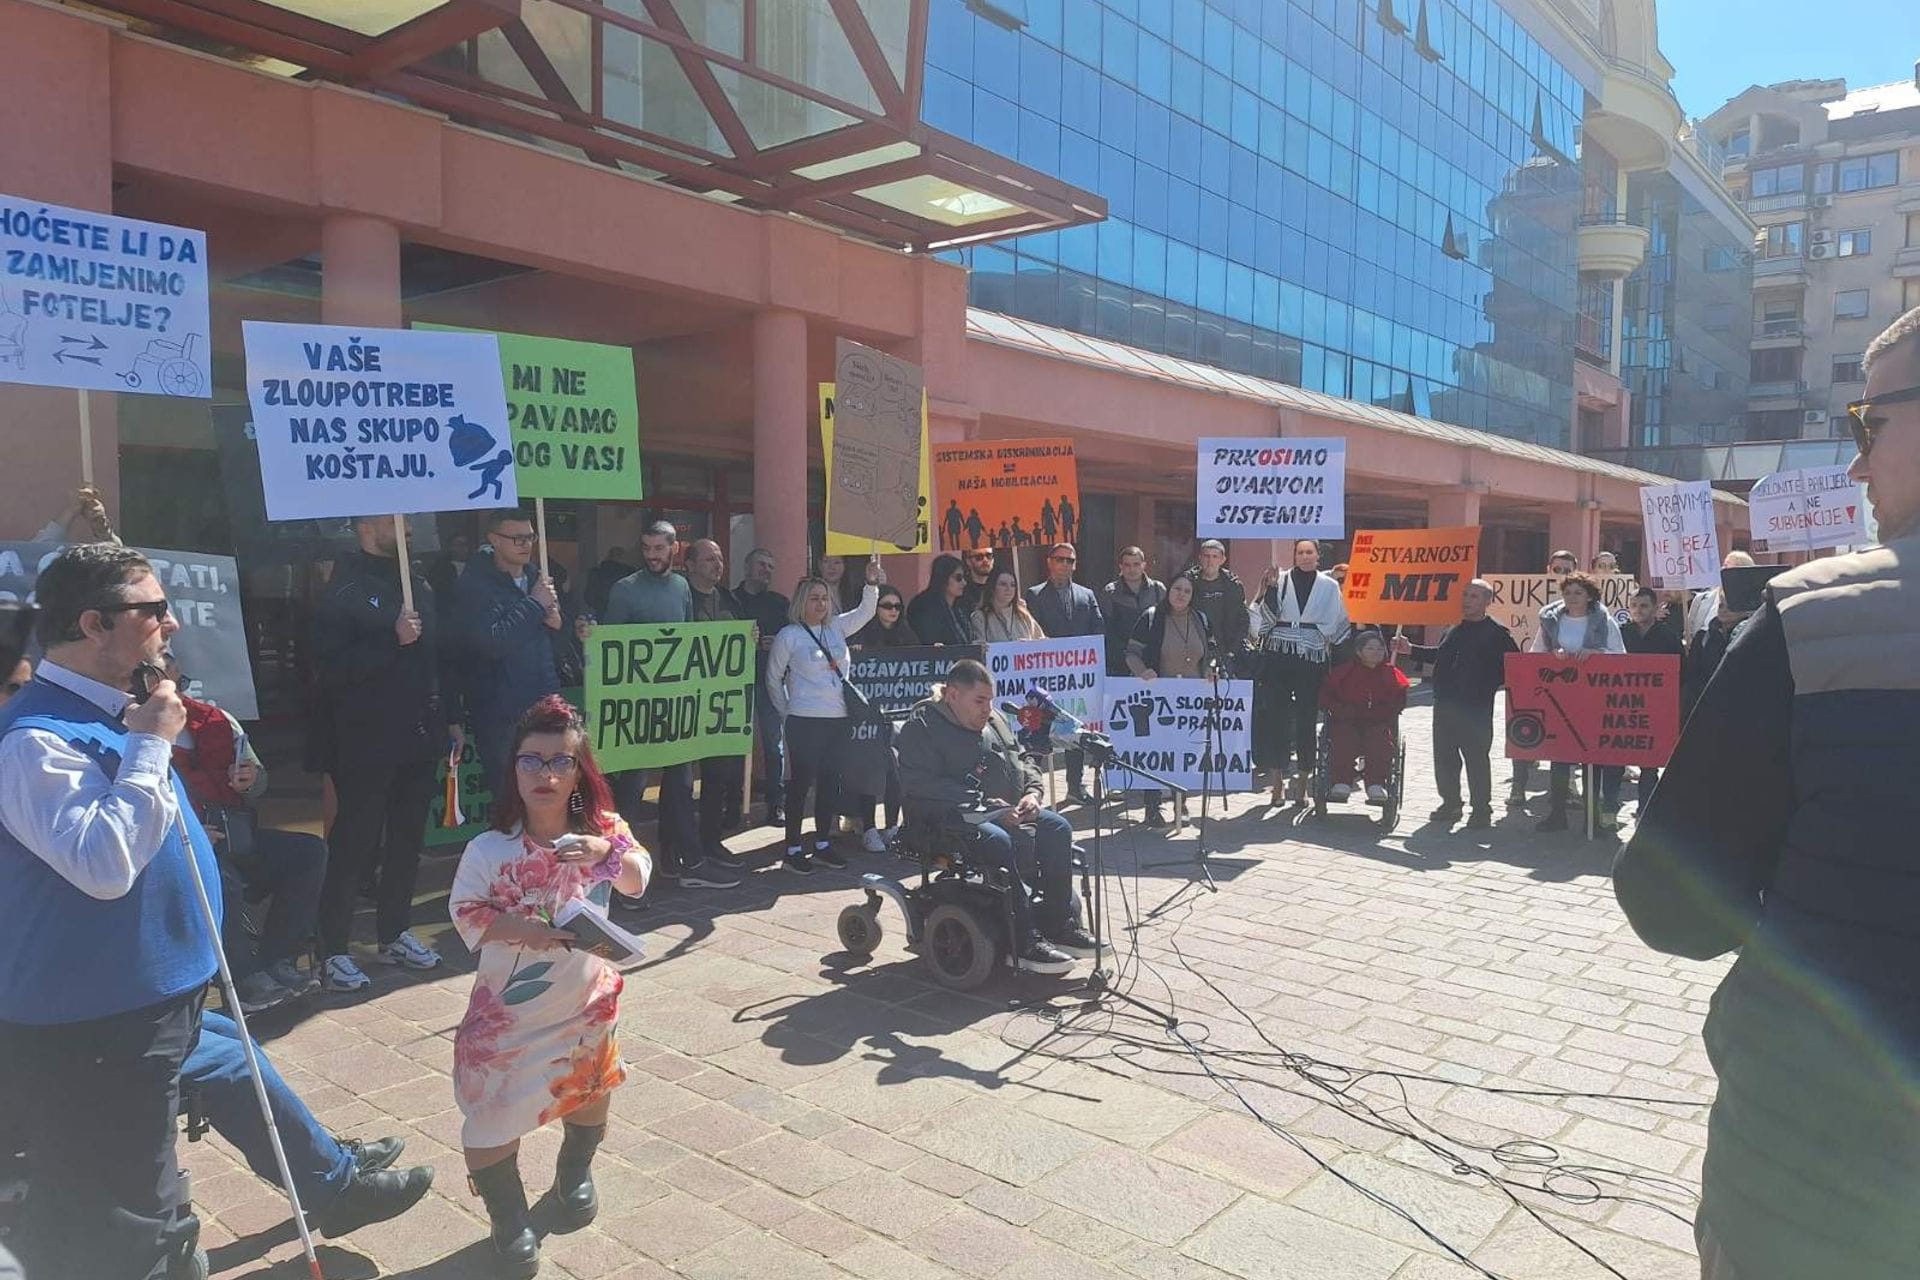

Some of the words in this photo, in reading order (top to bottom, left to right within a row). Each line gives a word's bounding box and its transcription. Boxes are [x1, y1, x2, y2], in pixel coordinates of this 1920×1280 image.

[122, 229, 147, 256] LI
[159, 236, 197, 263] DA
[7, 250, 186, 296] ZAMIJENIMO
[22, 289, 172, 332] FOTELJE?
[303, 336, 382, 372] VAŠE
[512, 364, 541, 393] MI
[552, 367, 586, 396] NE
[262, 378, 455, 408] ZLOUPOTREBE
[290, 417, 347, 444] NAS
[358, 416, 440, 444] SKUPO
[507, 402, 618, 434] PAVAMO
[306, 446, 435, 480] KOŠTAJU.
[516, 441, 551, 468] OG
[561, 443, 625, 472] VAS!
[1213, 448, 1328, 466] PRKOSIMO
[958, 475, 987, 490] NAŠA
[1215, 476, 1324, 494] OVAKVOM
[1215, 505, 1323, 524] SISTEMU!
[1807, 496, 1821, 508] NE
[1662, 516, 1684, 533] OSI
[1768, 507, 1843, 532] SUBVENCIJE
[1369, 545, 1474, 564] STVARNOST
[1653, 539, 1670, 554] NE
[1682, 533, 1713, 552] BEZ
[1665, 556, 1693, 576] OSI
[1352, 573, 1371, 587] VI
[1380, 573, 1459, 602] MIT
[1511, 614, 1528, 628] DA
[601, 628, 747, 686] DRŽAVO
[848, 658, 929, 679] ROŽAVATE
[992, 655, 1009, 673] OD
[1014, 648, 1098, 671] INSTITUCIJA
[996, 679, 1026, 697] NAM
[1030, 672, 1095, 692] TREBAJU
[1586, 672, 1664, 688] VRATITE
[705, 683, 754, 736] SE!
[1606, 693, 1645, 709] NAM
[1602, 710, 1650, 729] NAŠE
[1598, 734, 1654, 750] PARE!
[1183, 749, 1251, 774] PADA!
